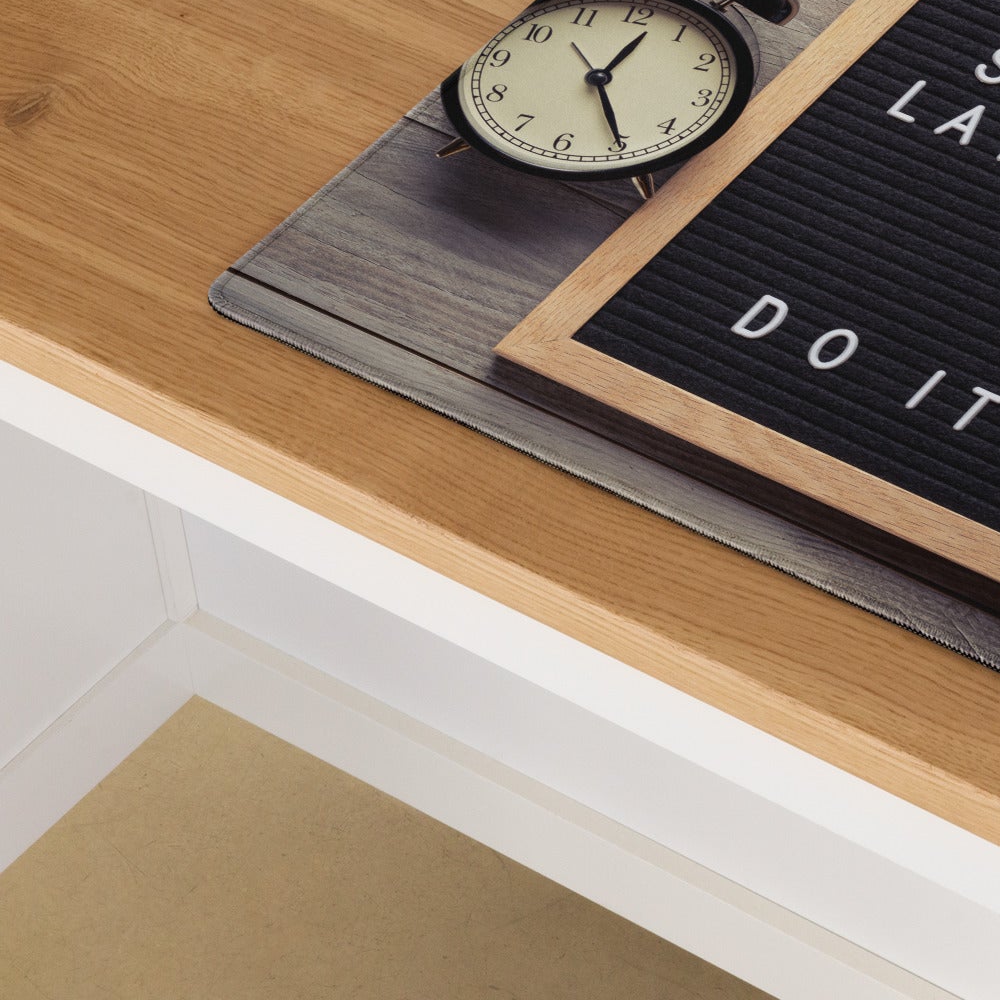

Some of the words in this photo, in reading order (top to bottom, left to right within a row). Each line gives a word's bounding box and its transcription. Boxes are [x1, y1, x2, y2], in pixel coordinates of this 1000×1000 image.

[570, 6, 600, 28] 11
[620, 5, 655, 27] 12
[521, 23, 553, 44] 10
[671, 24, 687, 43] 1
[489, 49, 511, 68] 9
[692, 53, 716, 72] 2
[485, 83, 508, 103] 8
[691, 88, 713, 108] 3
[514, 113, 535, 132] 7
[656, 117, 677, 136] 4
[552, 132, 575, 151] 6
[730, 294, 859, 370] DO
